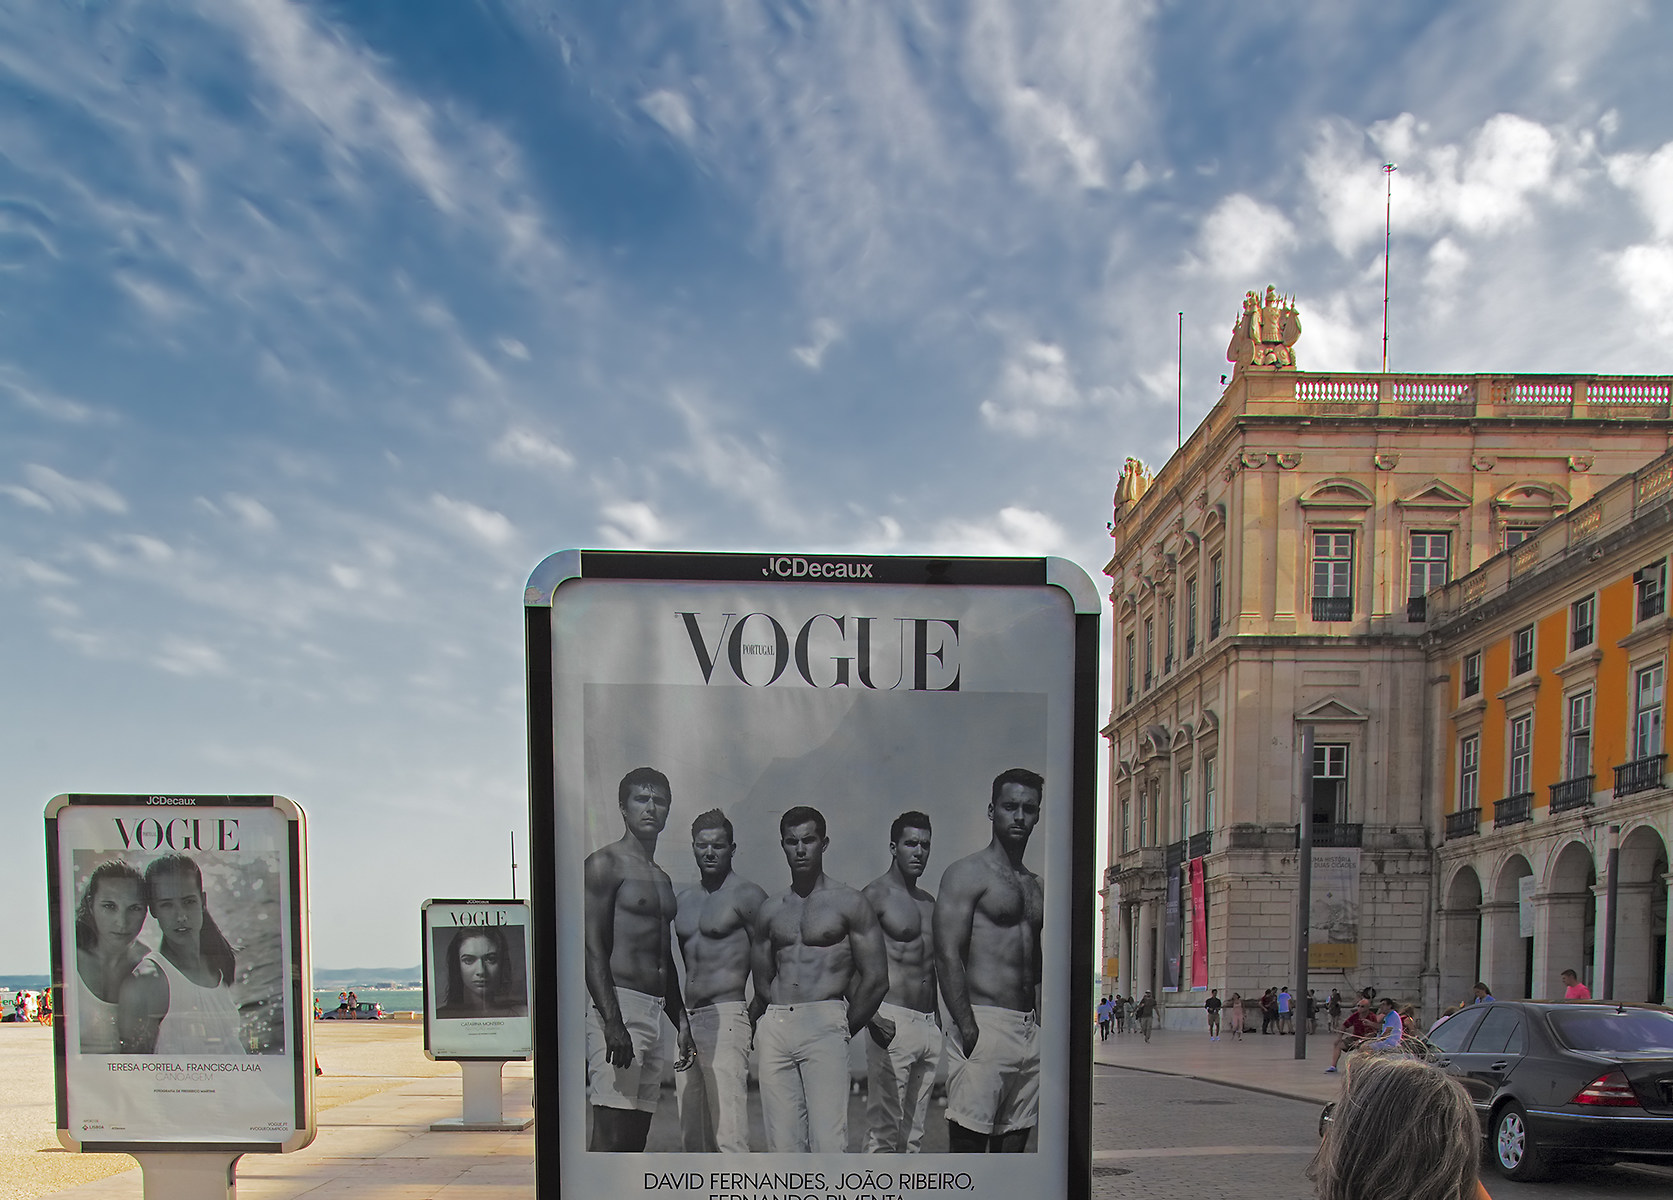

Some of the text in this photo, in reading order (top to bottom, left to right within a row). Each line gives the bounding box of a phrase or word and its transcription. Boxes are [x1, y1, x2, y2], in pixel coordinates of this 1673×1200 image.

[762, 557, 874, 578] JCDecaux
[674, 611, 961, 692] VOGUE
[742, 644, 775, 656] PORTUGAL
[146, 796, 196, 806] JCDecaux
[112, 817, 241, 851] VOGUE
[450, 910, 508, 927] VOGUE
[107, 1063, 262, 1072] TERESA PORTELA, FRANCISCA LAIA
[644, 1170, 975, 1191] DAVID FERNANDES, JOÃO RIBEIRO,
